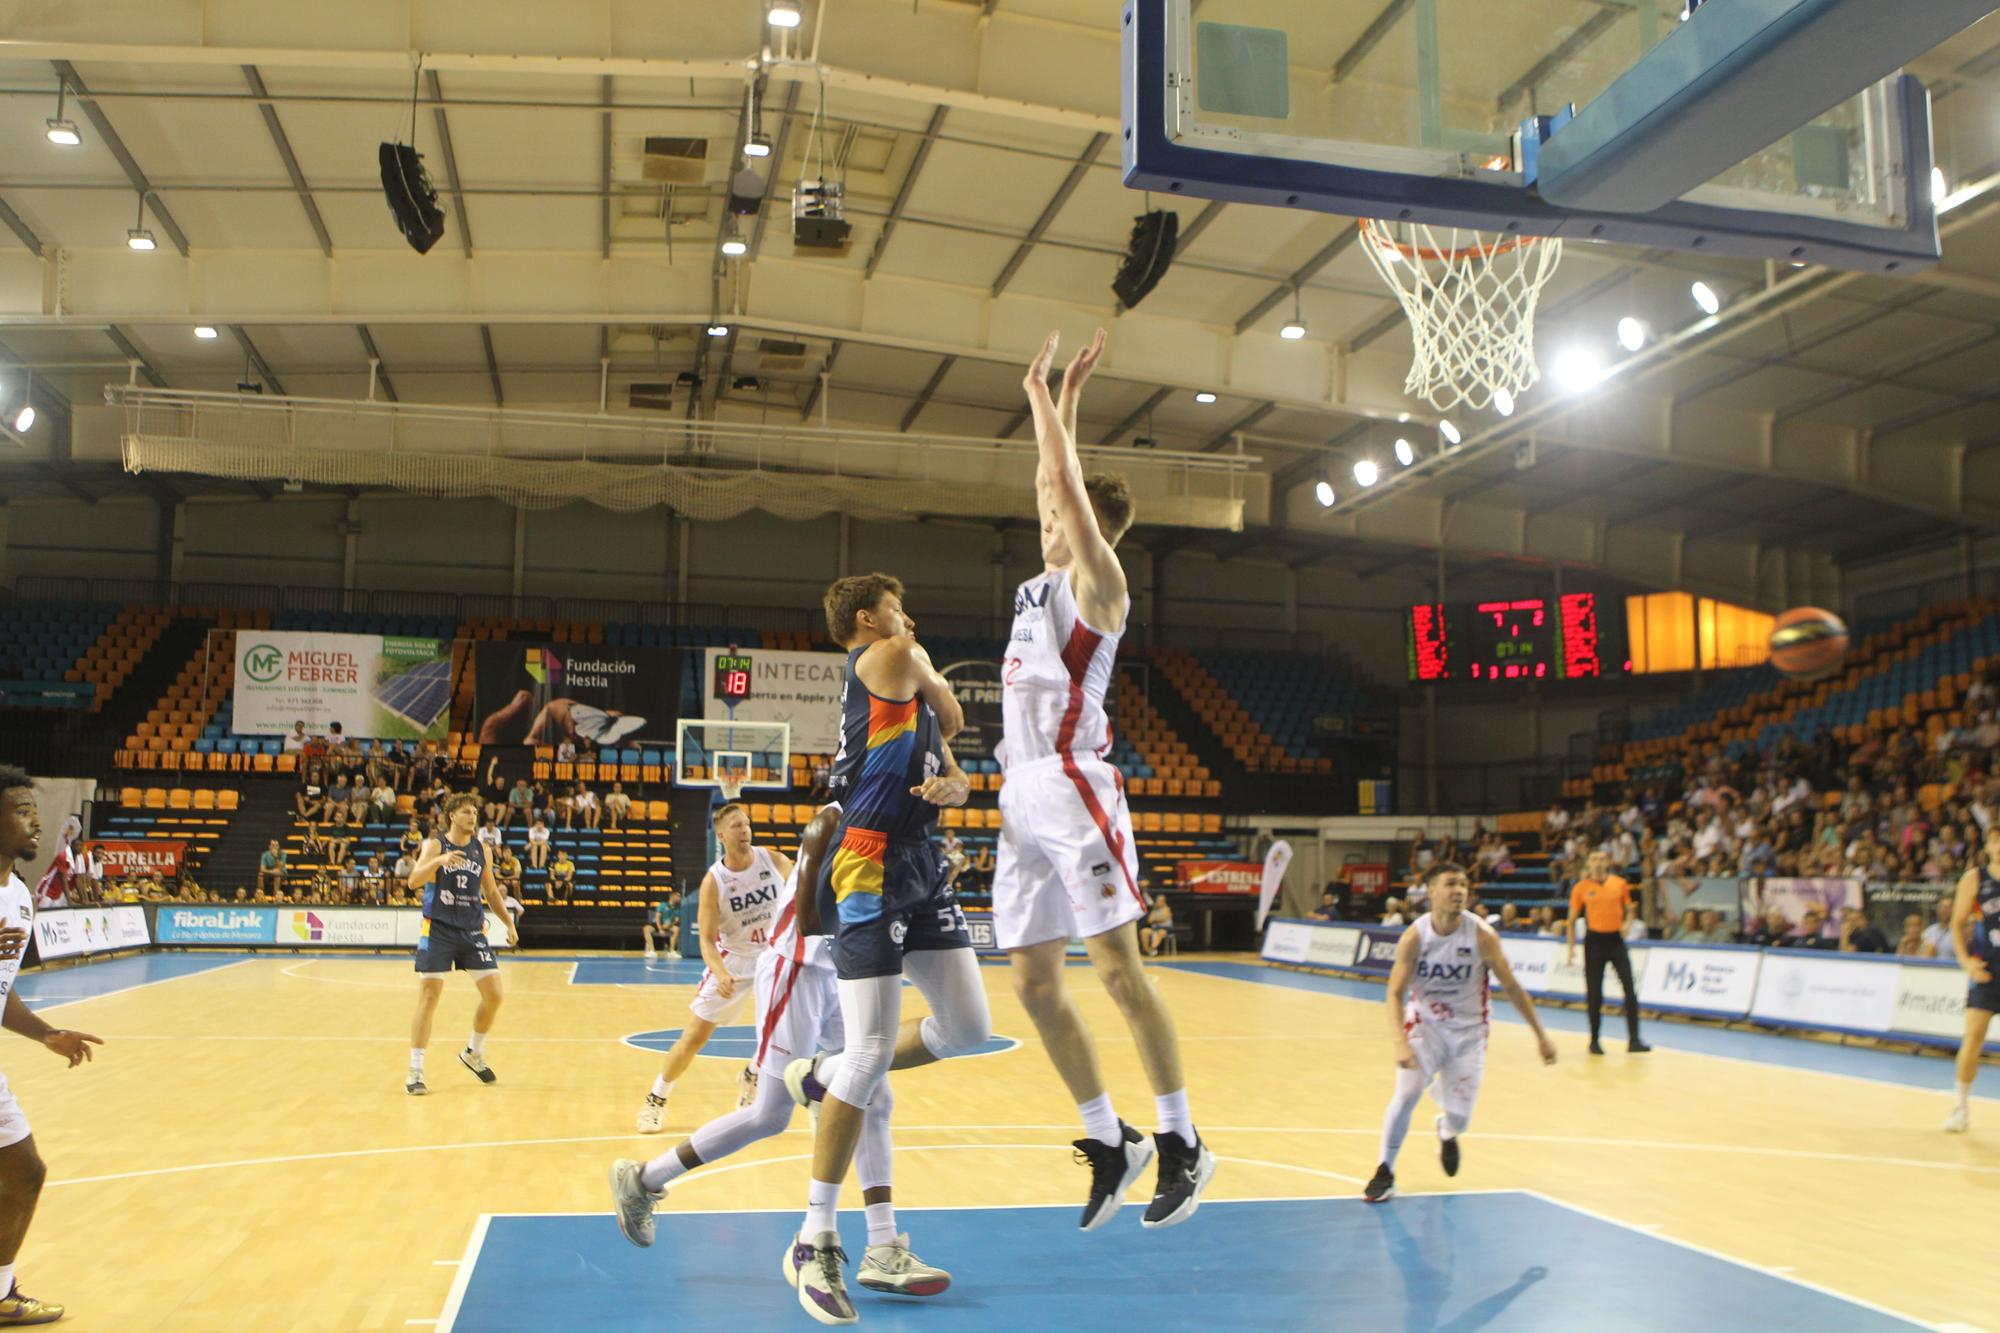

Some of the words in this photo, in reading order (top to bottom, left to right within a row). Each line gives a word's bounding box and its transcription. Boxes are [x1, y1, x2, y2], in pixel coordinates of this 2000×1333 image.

[288, 651, 358, 668] MIGUEL
[567, 658, 636, 674] Fundación
[288, 667, 358, 683] FEBRER
[566, 673, 608, 688] Hestia
[727, 671, 748, 695] 18
[796, 693, 825, 704] Apple
[456, 875, 468, 889] 12
[1207, 870, 1263, 885] ESTRELL
[729, 884, 778, 912] BAXI
[173, 911, 263, 929] fibraLink
[328, 920, 389, 931] Fundación
[328, 933, 364, 942] Hestia
[751, 928, 767, 944] 41
[1416, 960, 1472, 980] BAXI
